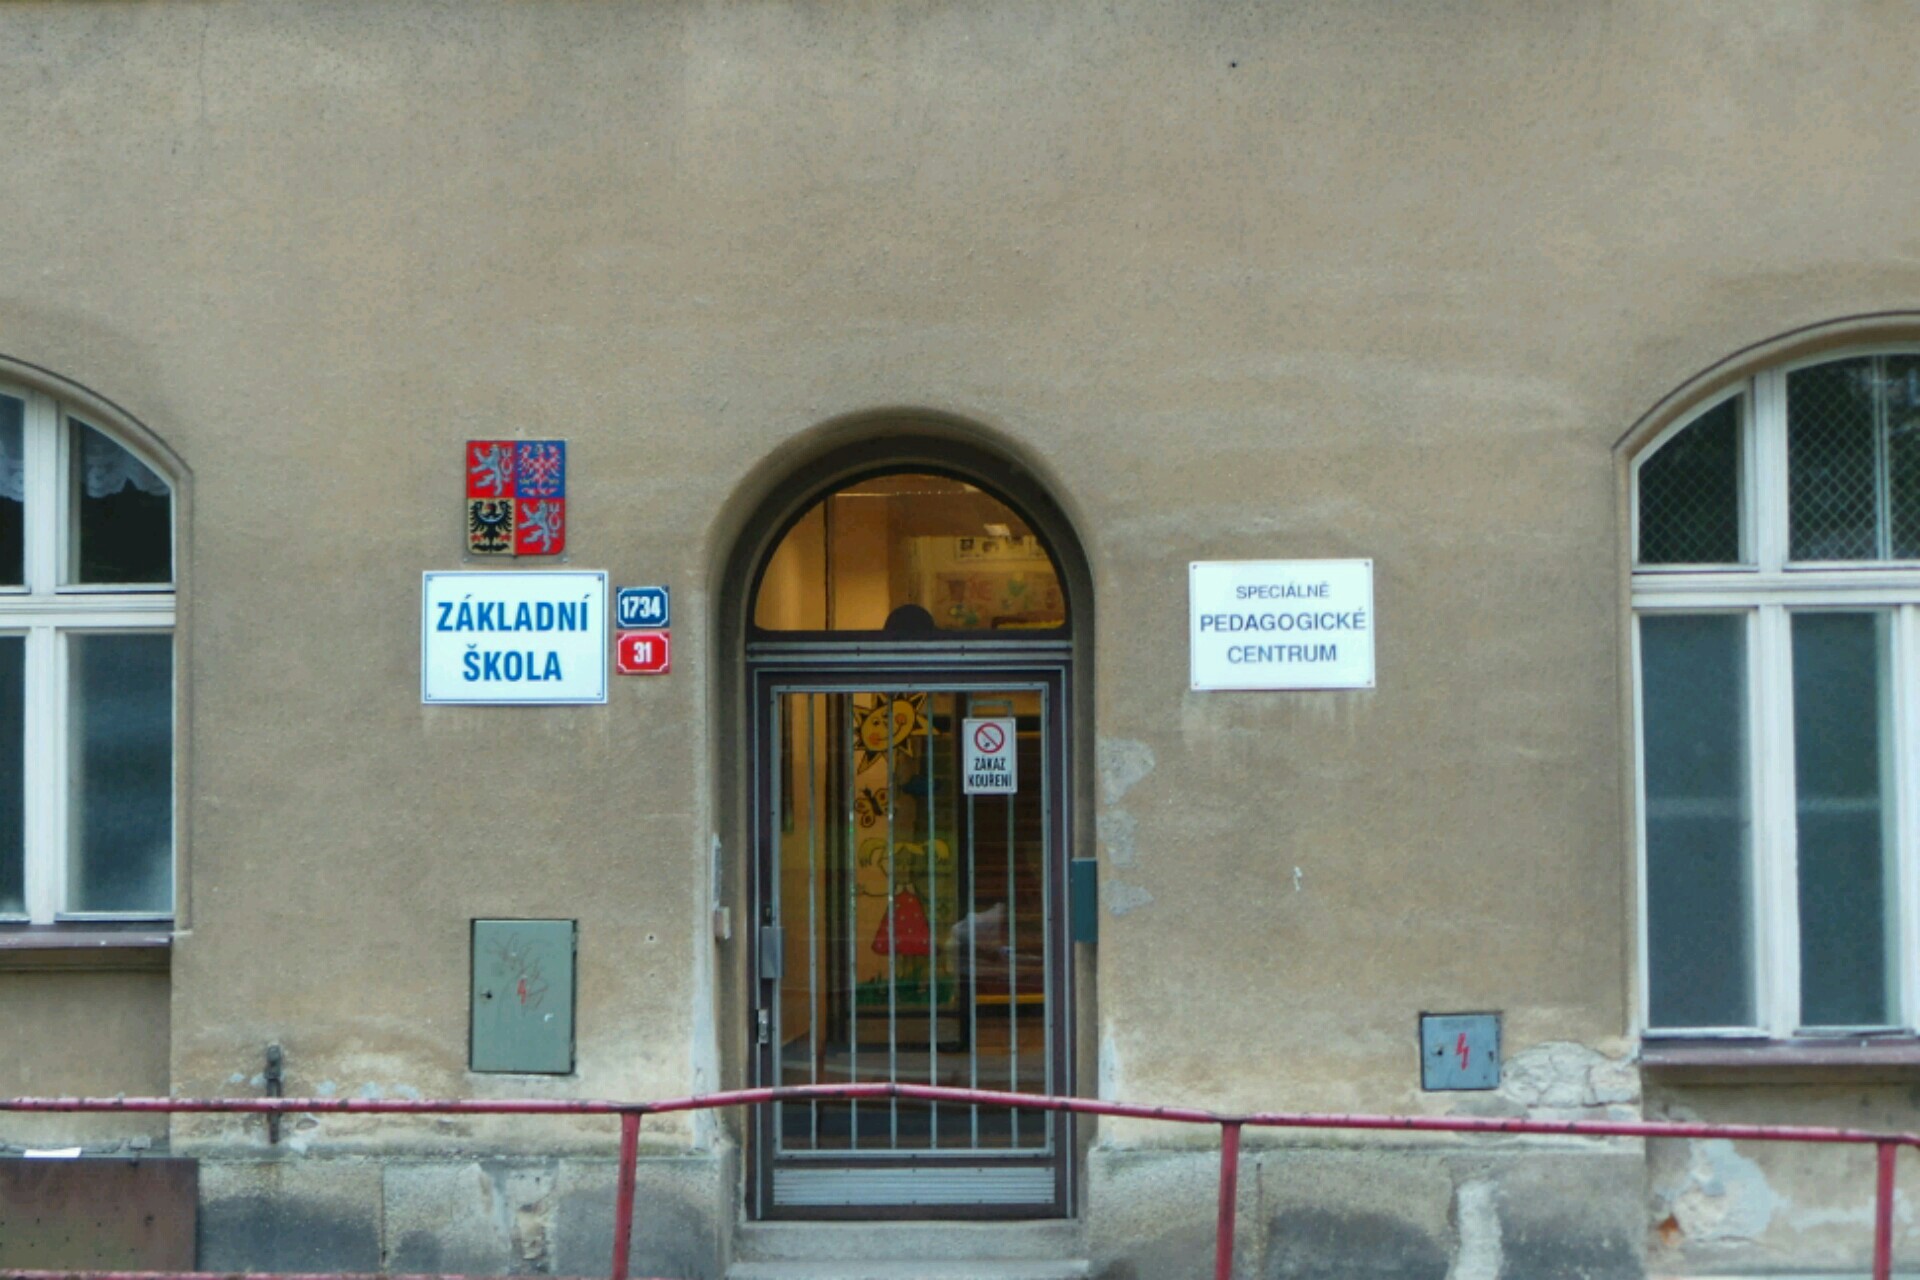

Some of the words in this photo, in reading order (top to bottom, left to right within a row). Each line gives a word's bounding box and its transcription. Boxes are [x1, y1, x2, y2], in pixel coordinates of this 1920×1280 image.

[438, 594, 591, 631] ZÁKLADNÍ
[621, 596, 661, 619] 1734
[1200, 607, 1366, 632] PEDAGOGICKÉ
[463, 643, 563, 681] ŠKOLA
[633, 642, 652, 663] 31
[1228, 643, 1337, 664] CENTRUM
